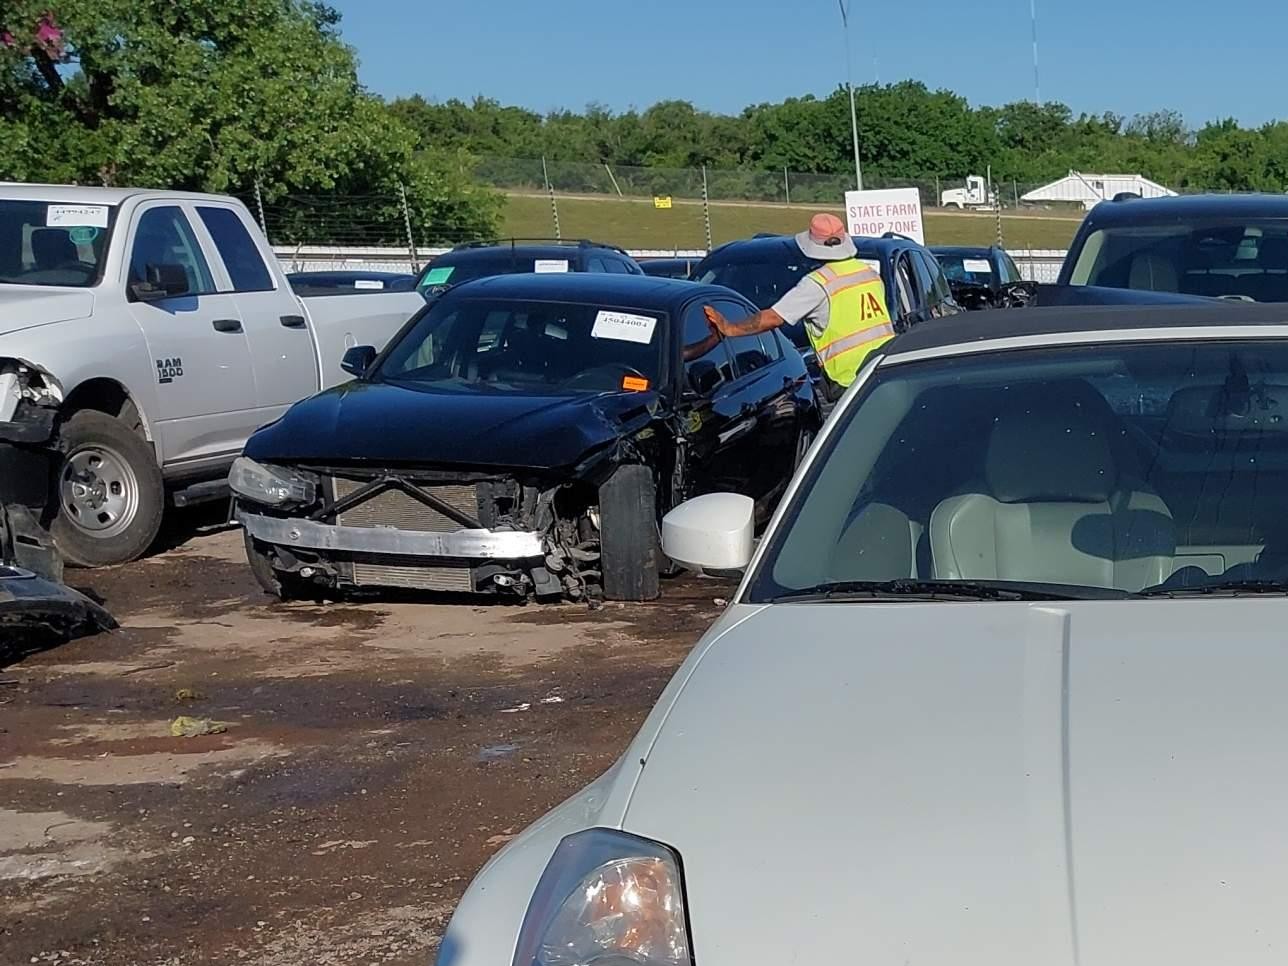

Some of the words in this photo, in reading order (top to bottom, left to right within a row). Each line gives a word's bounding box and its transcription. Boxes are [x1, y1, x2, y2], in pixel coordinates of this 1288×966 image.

[849, 205, 883, 218] STATE
[886, 203, 918, 217] FARM
[853, 222, 884, 235] DROP
[887, 220, 918, 233] ZONE
[156, 358, 182, 368] RAM
[157, 367, 184, 378] 1500
